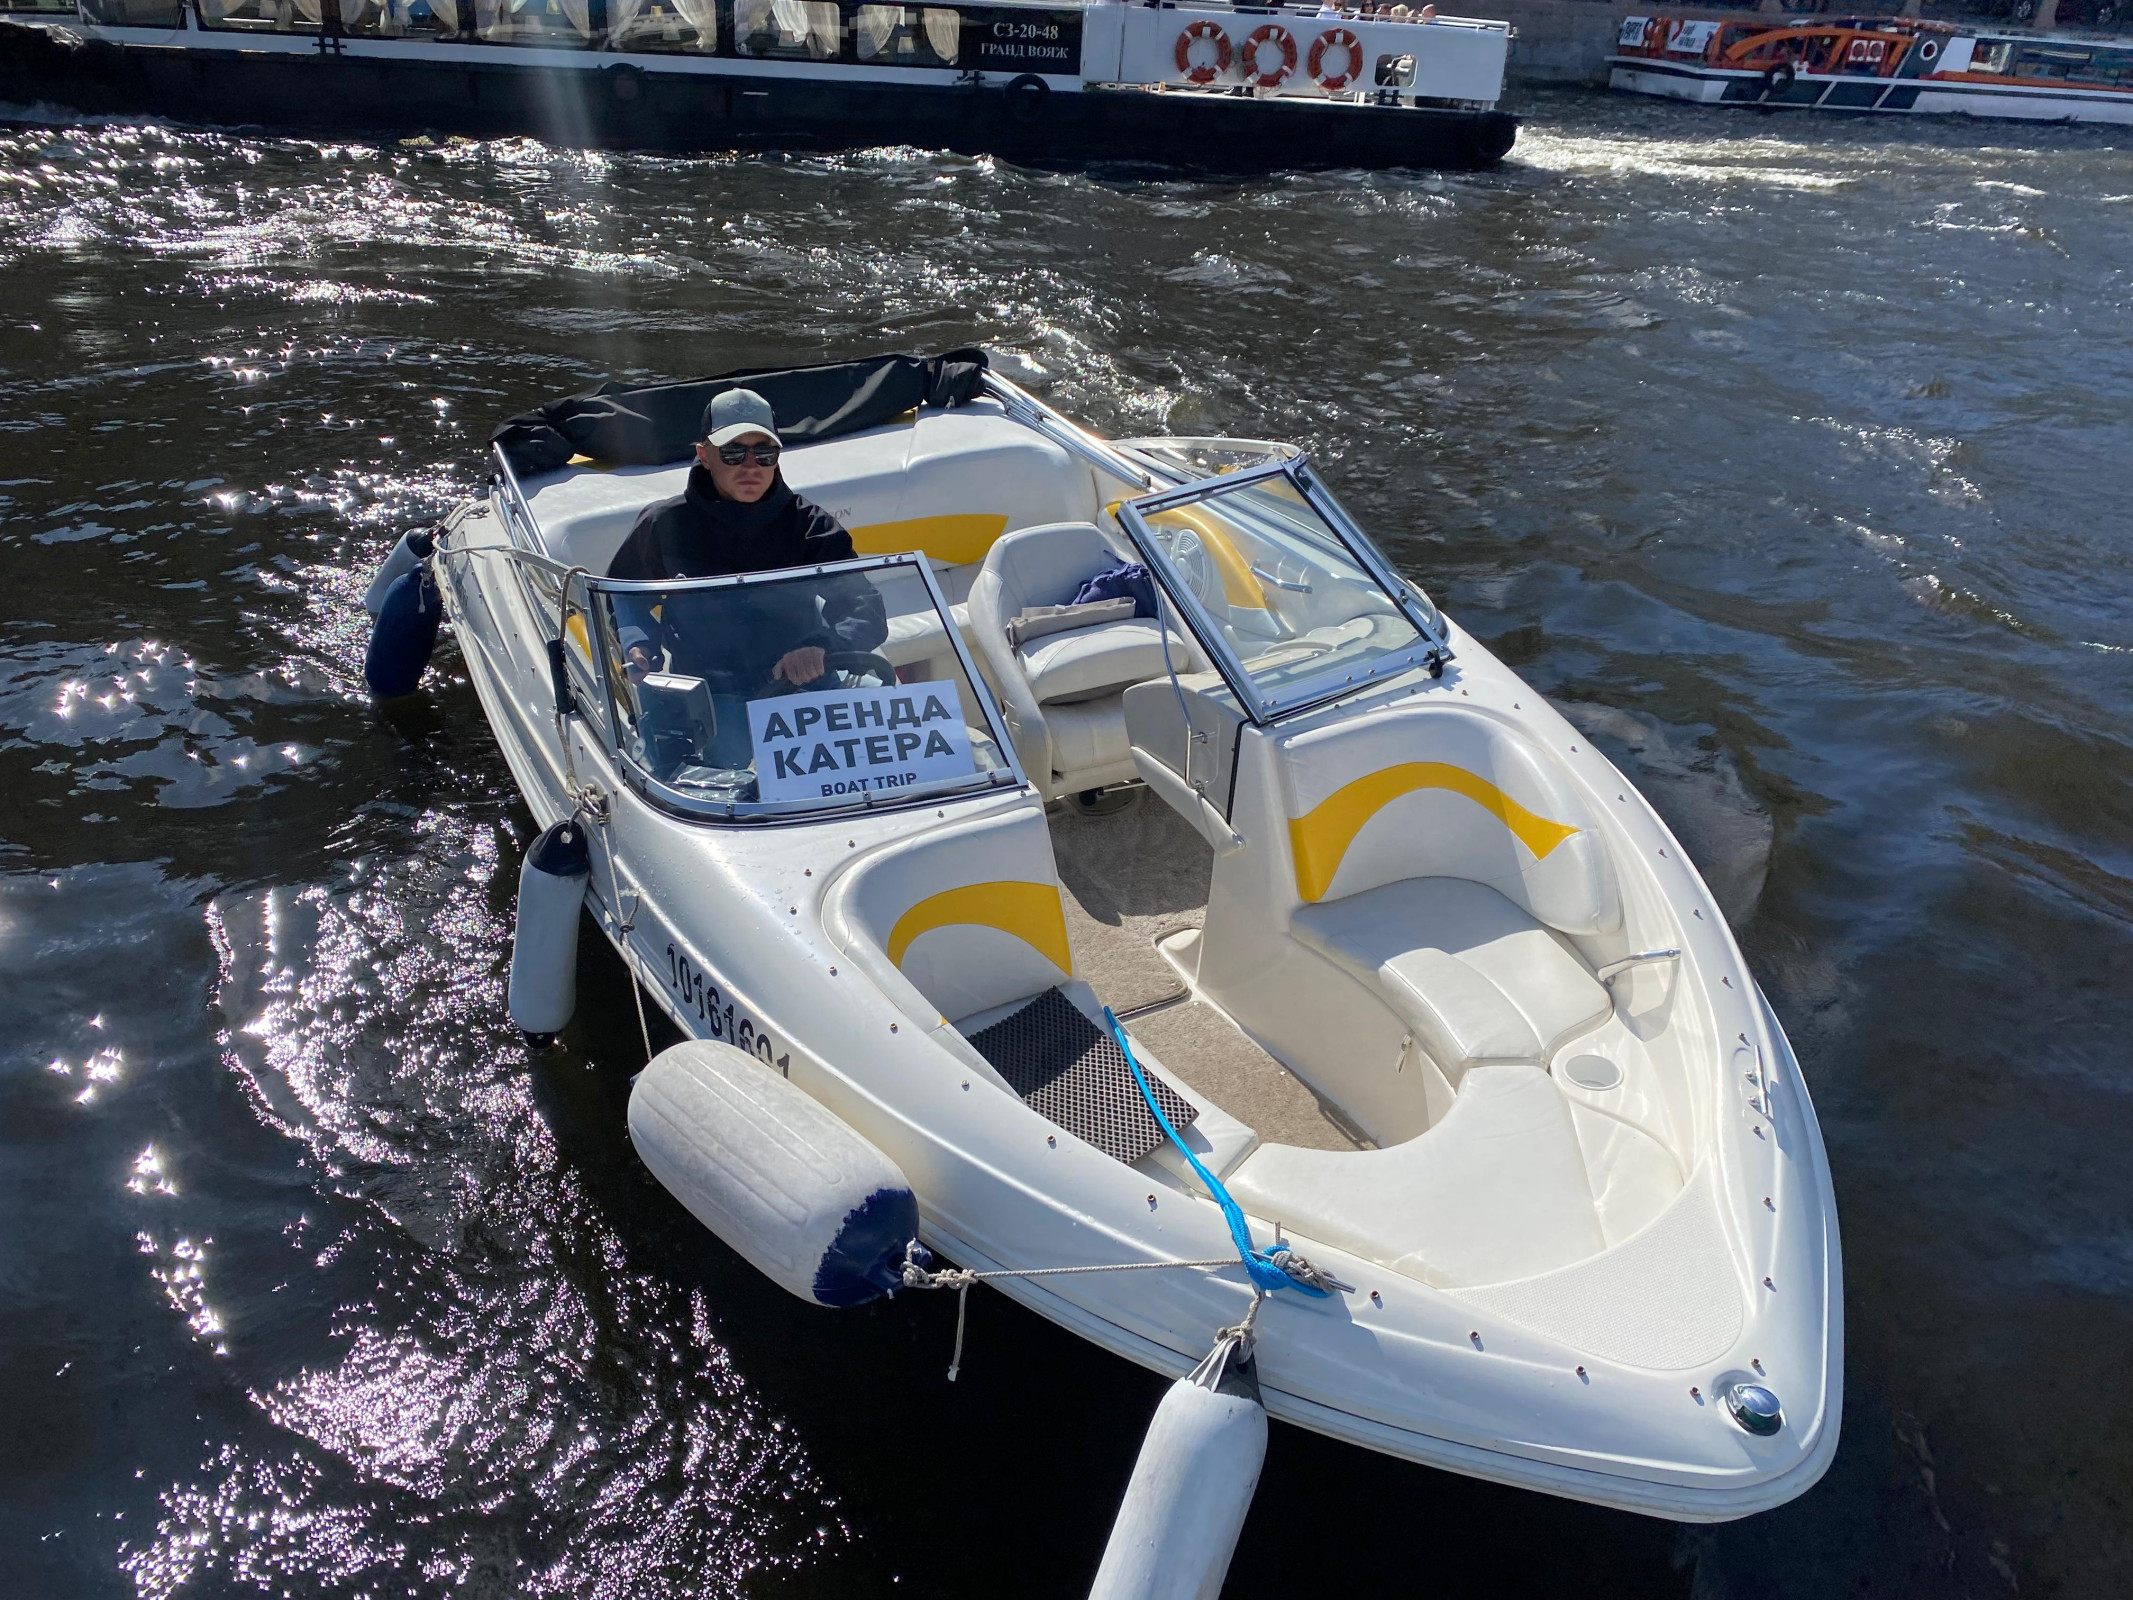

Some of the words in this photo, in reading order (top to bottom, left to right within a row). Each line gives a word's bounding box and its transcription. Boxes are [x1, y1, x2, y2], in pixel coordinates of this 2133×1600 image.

[993, 22, 1059, 40] СЗ-20-48
[981, 43, 1025, 58] ГРАНД
[1028, 45, 1069, 59] ВОЯЖ
[763, 694, 952, 743] АРЕНДА
[774, 729, 956, 780] КАТЕРА
[821, 778, 869, 798] BOAT
[874, 772, 917, 790] TRIP
